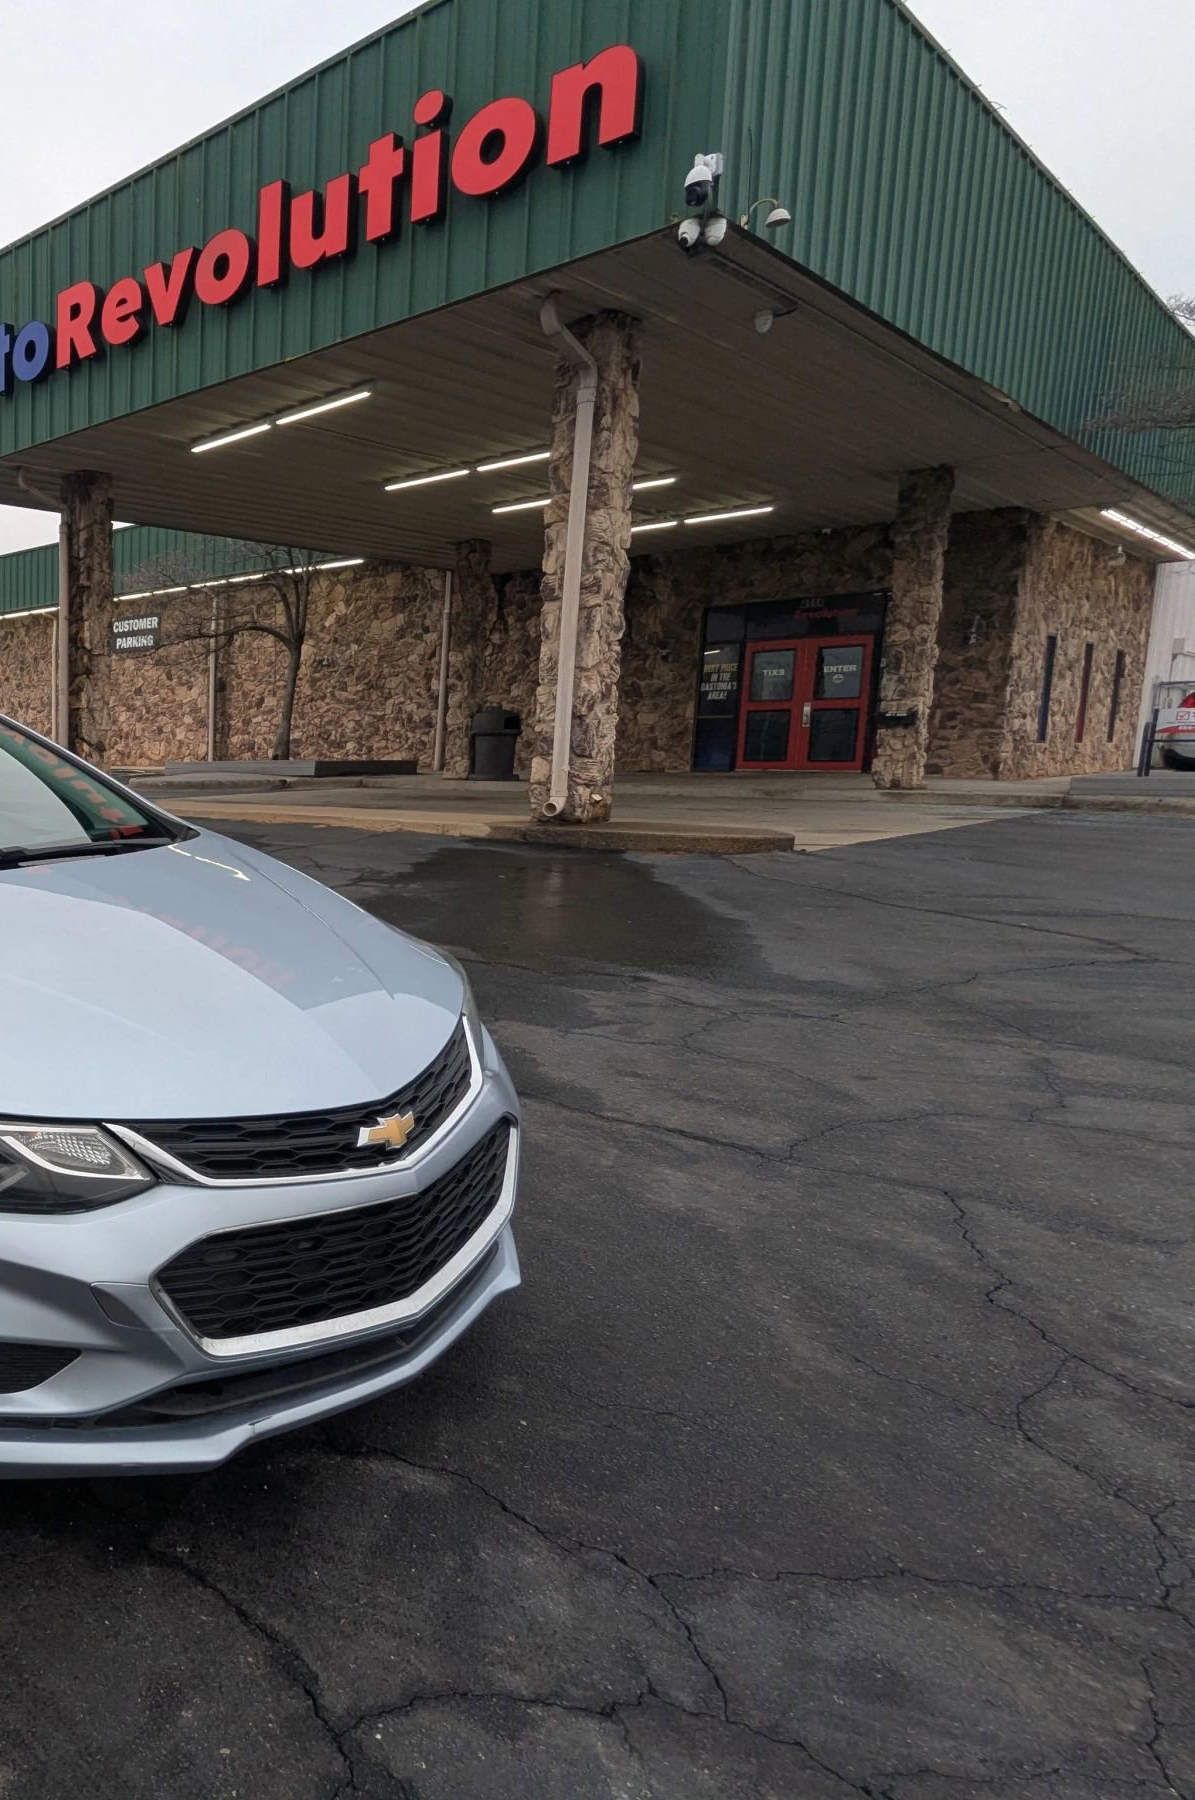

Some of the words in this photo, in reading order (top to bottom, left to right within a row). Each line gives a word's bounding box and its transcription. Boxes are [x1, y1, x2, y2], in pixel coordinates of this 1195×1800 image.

[113, 616, 158, 633] CUSTOMER
[116, 635, 154, 649] PARKING
[823, 664, 857, 673] ENTER
[710, 673, 718, 681] IN
[719, 672, 731, 681] THE
[707, 691, 727, 700] AREA!
